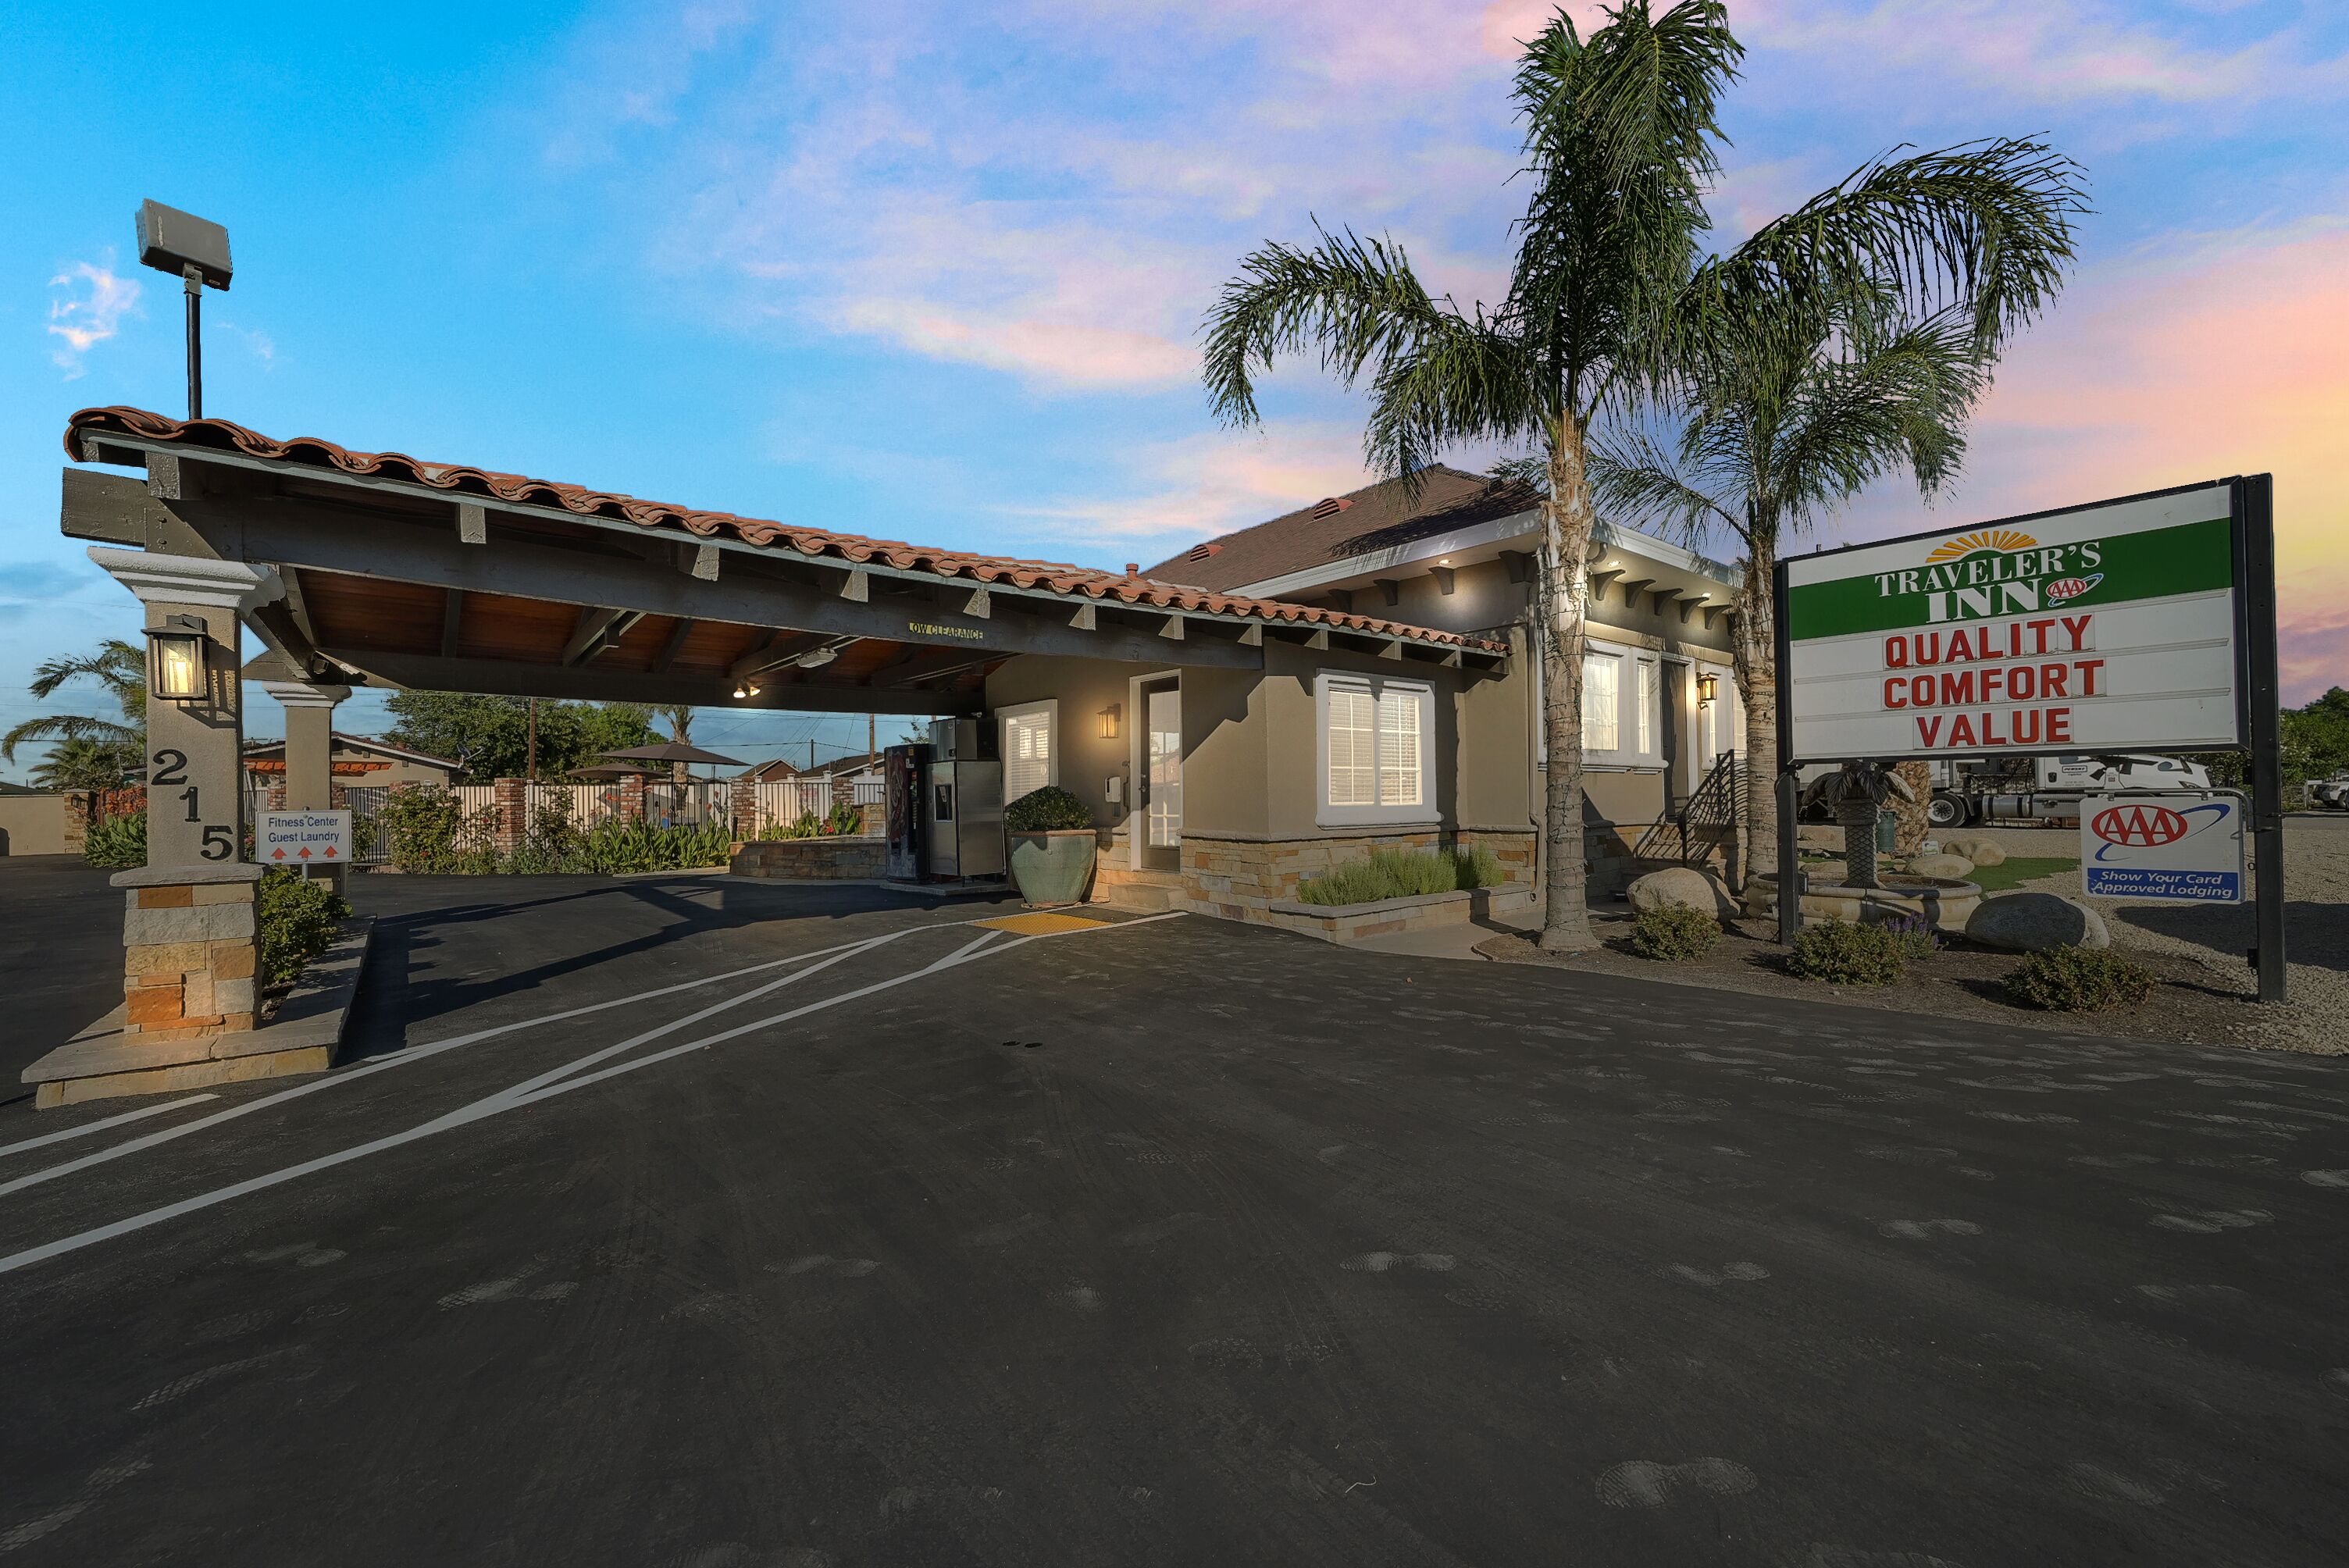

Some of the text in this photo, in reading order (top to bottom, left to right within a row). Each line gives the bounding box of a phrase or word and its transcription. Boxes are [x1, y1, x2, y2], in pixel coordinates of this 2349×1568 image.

[1874, 541, 2101, 597] TRAVELER'S
[1926, 578, 2043, 623] INN
[2048, 580, 2086, 598] AAA
[931, 625, 982, 639] CLEARANCE
[1885, 615, 2093, 668] QUALITY
[1884, 659, 2105, 708] COMFORT
[1916, 707, 2071, 747] VALUE
[269, 816, 338, 828] Fitness Center
[269, 830, 340, 843] Guest Laundry
[2102, 806, 2177, 846] AAA
[2092, 881, 2233, 899] Approved Lodging
[2101, 871, 2222, 885] Show Your Card
